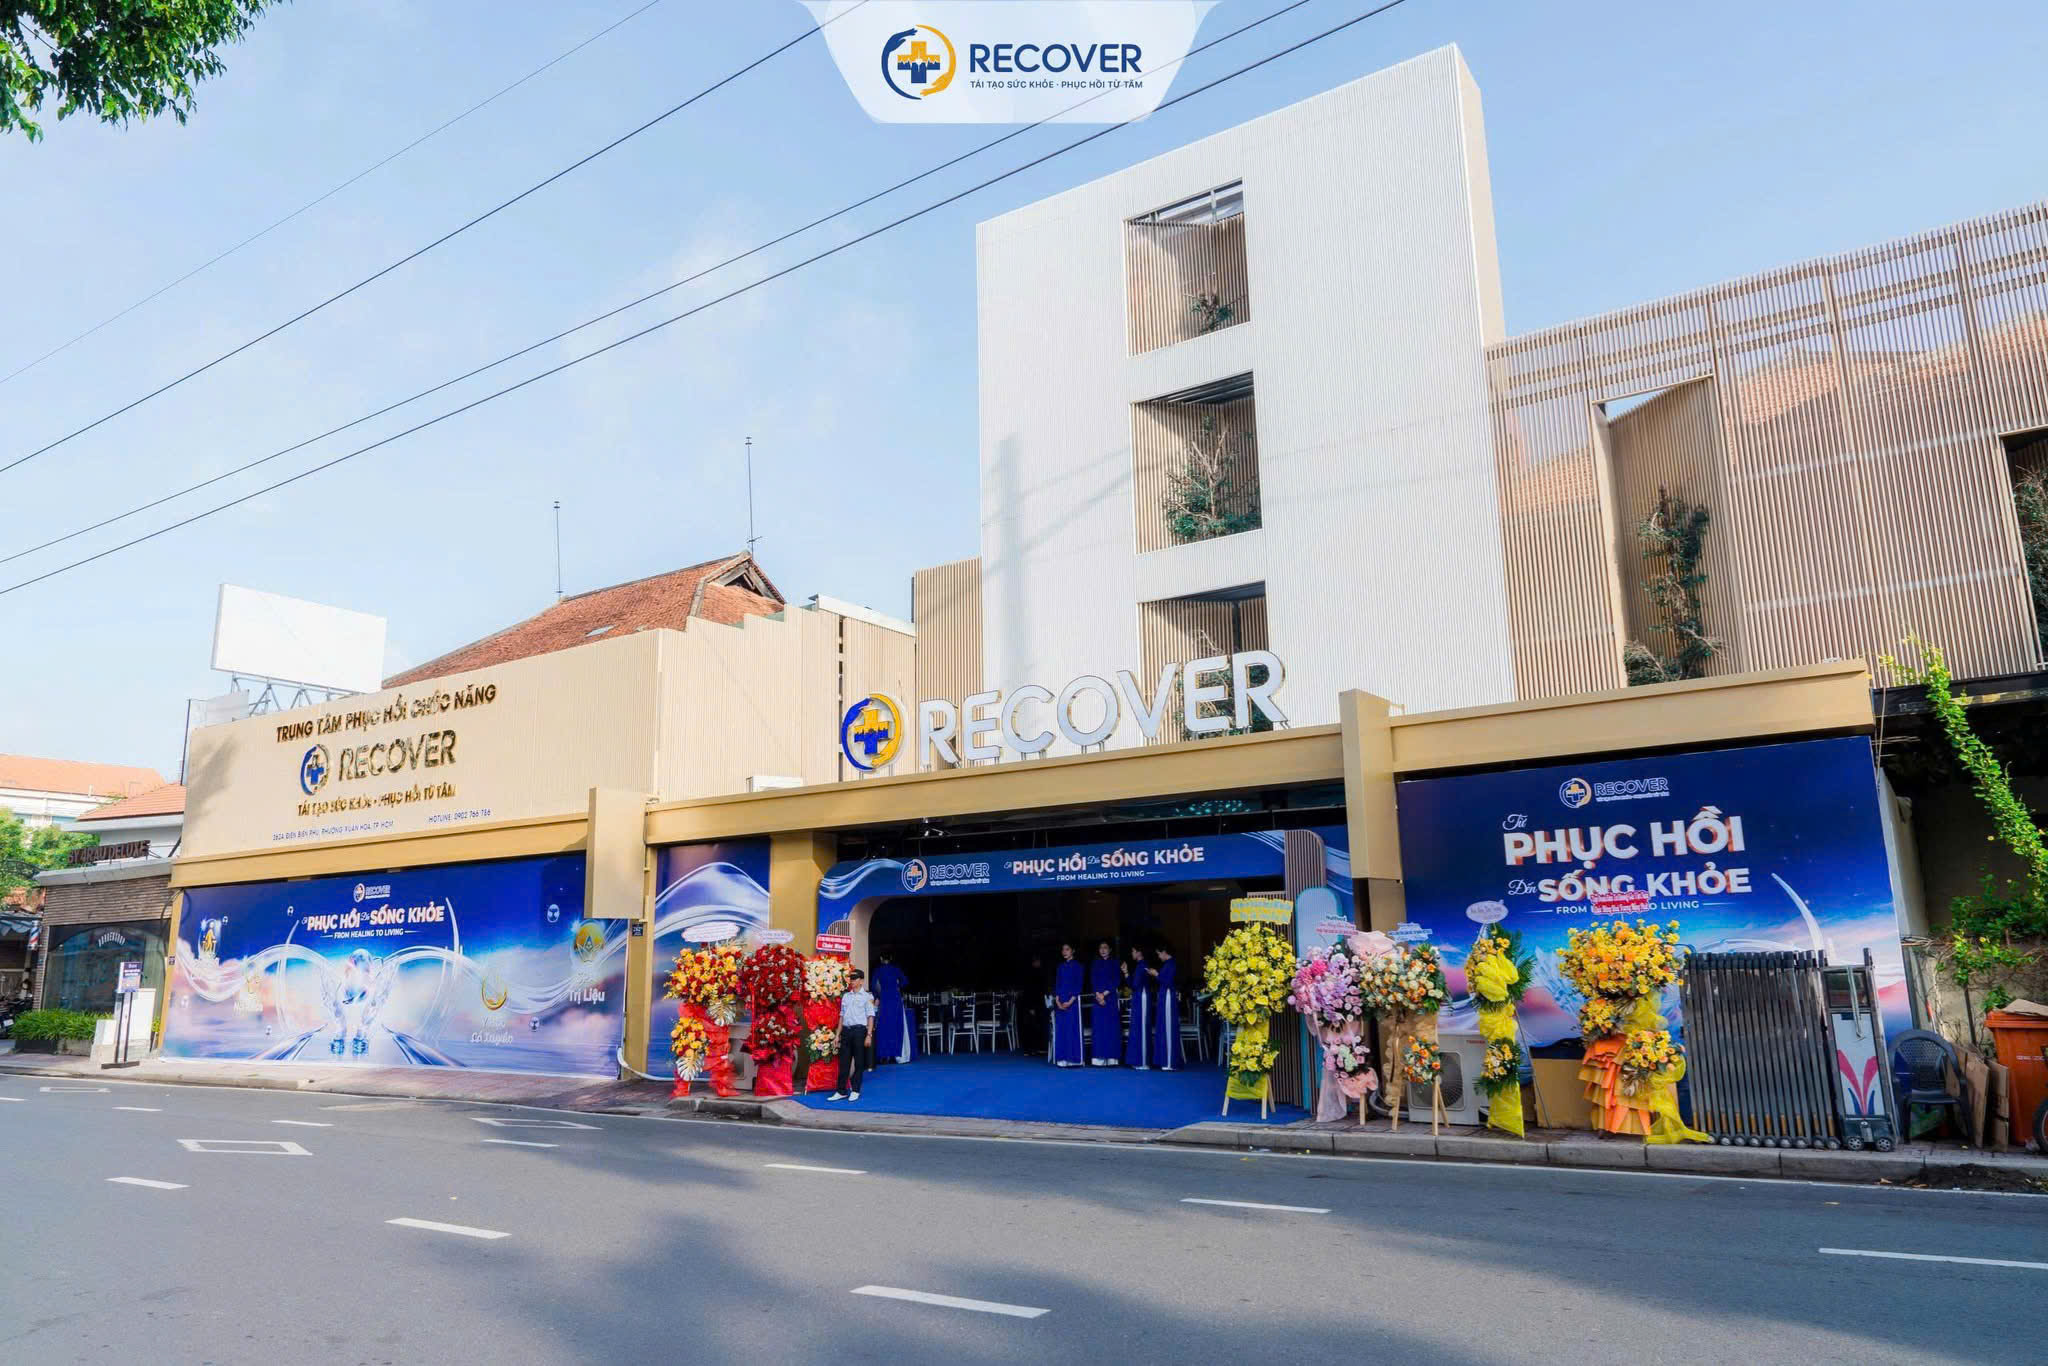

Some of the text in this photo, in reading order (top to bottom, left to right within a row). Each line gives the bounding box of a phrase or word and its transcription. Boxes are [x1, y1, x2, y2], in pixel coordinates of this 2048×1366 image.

[276, 720, 313, 743] TRUNG
[317, 713, 342, 736] TÂM
[345, 710, 381, 732] PHỤC
[454, 684, 497, 710] NĂNG
[919, 649, 1288, 766] RECOVER
[338, 729, 457, 782] RECOVER
[1594, 777, 1669, 797] RECOVER
[1503, 805, 1745, 870] PHỤC HỒI
[929, 862, 990, 879] RECOVER
[1012, 858, 1055, 876] PHỤC
[1058, 852, 1087, 872] HỒI
[1101, 847, 1149, 868] SỐNG
[1154, 843, 1205, 865] KHỎE
[1077, 872, 1108, 880] HEALING
[1121, 870, 1145, 878] LIVING
[1538, 869, 1635, 903] SỐNG
[1647, 861, 1752, 898] KHỎE
[370, 901, 445, 926] SỐNG KHỎE
[1556, 906, 1587, 915] FROM
[1661, 900, 1700, 911] LIVING
[307, 914, 338, 933] PHỤC
[334, 928, 404, 939] FROM HEALING TO LIVING
